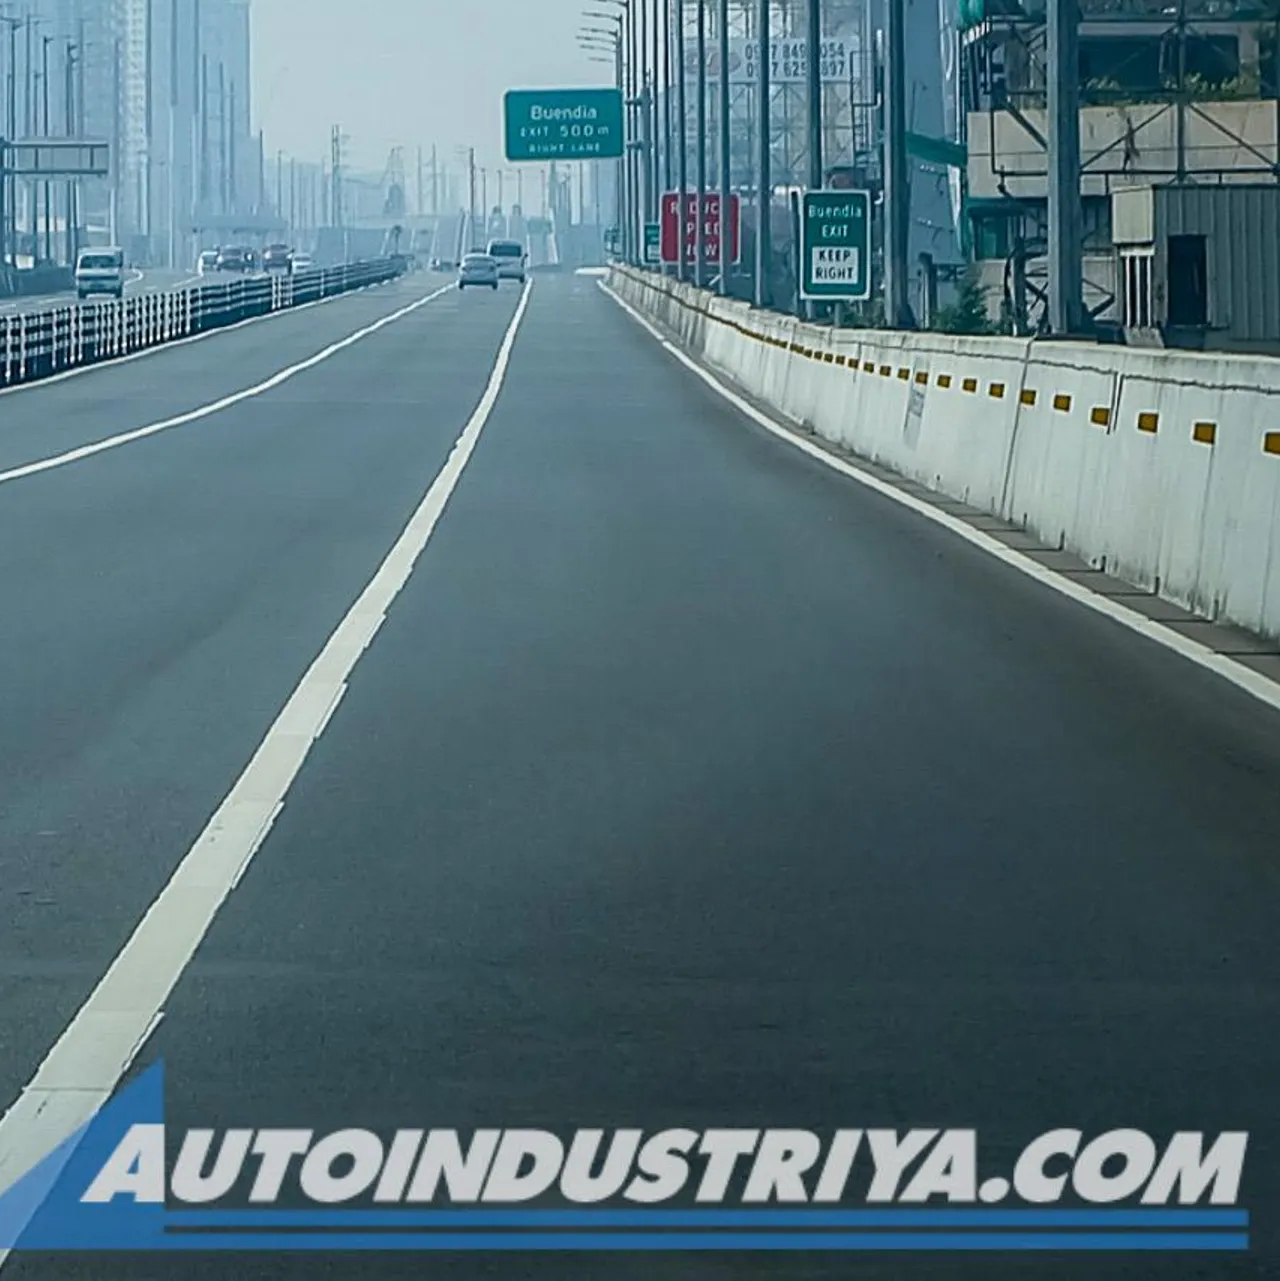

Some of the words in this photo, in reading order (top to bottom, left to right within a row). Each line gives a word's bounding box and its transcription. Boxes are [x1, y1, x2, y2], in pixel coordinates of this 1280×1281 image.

[745, 43, 778, 60] 097
[530, 104, 597, 120] Buendia
[520, 125, 549, 137] EXIT
[560, 123, 594, 138] 500
[808, 204, 862, 218] Buendia
[822, 224, 848, 238] EXIT
[819, 249, 851, 262] KEEP
[814, 267, 853, 280] RIGHT
